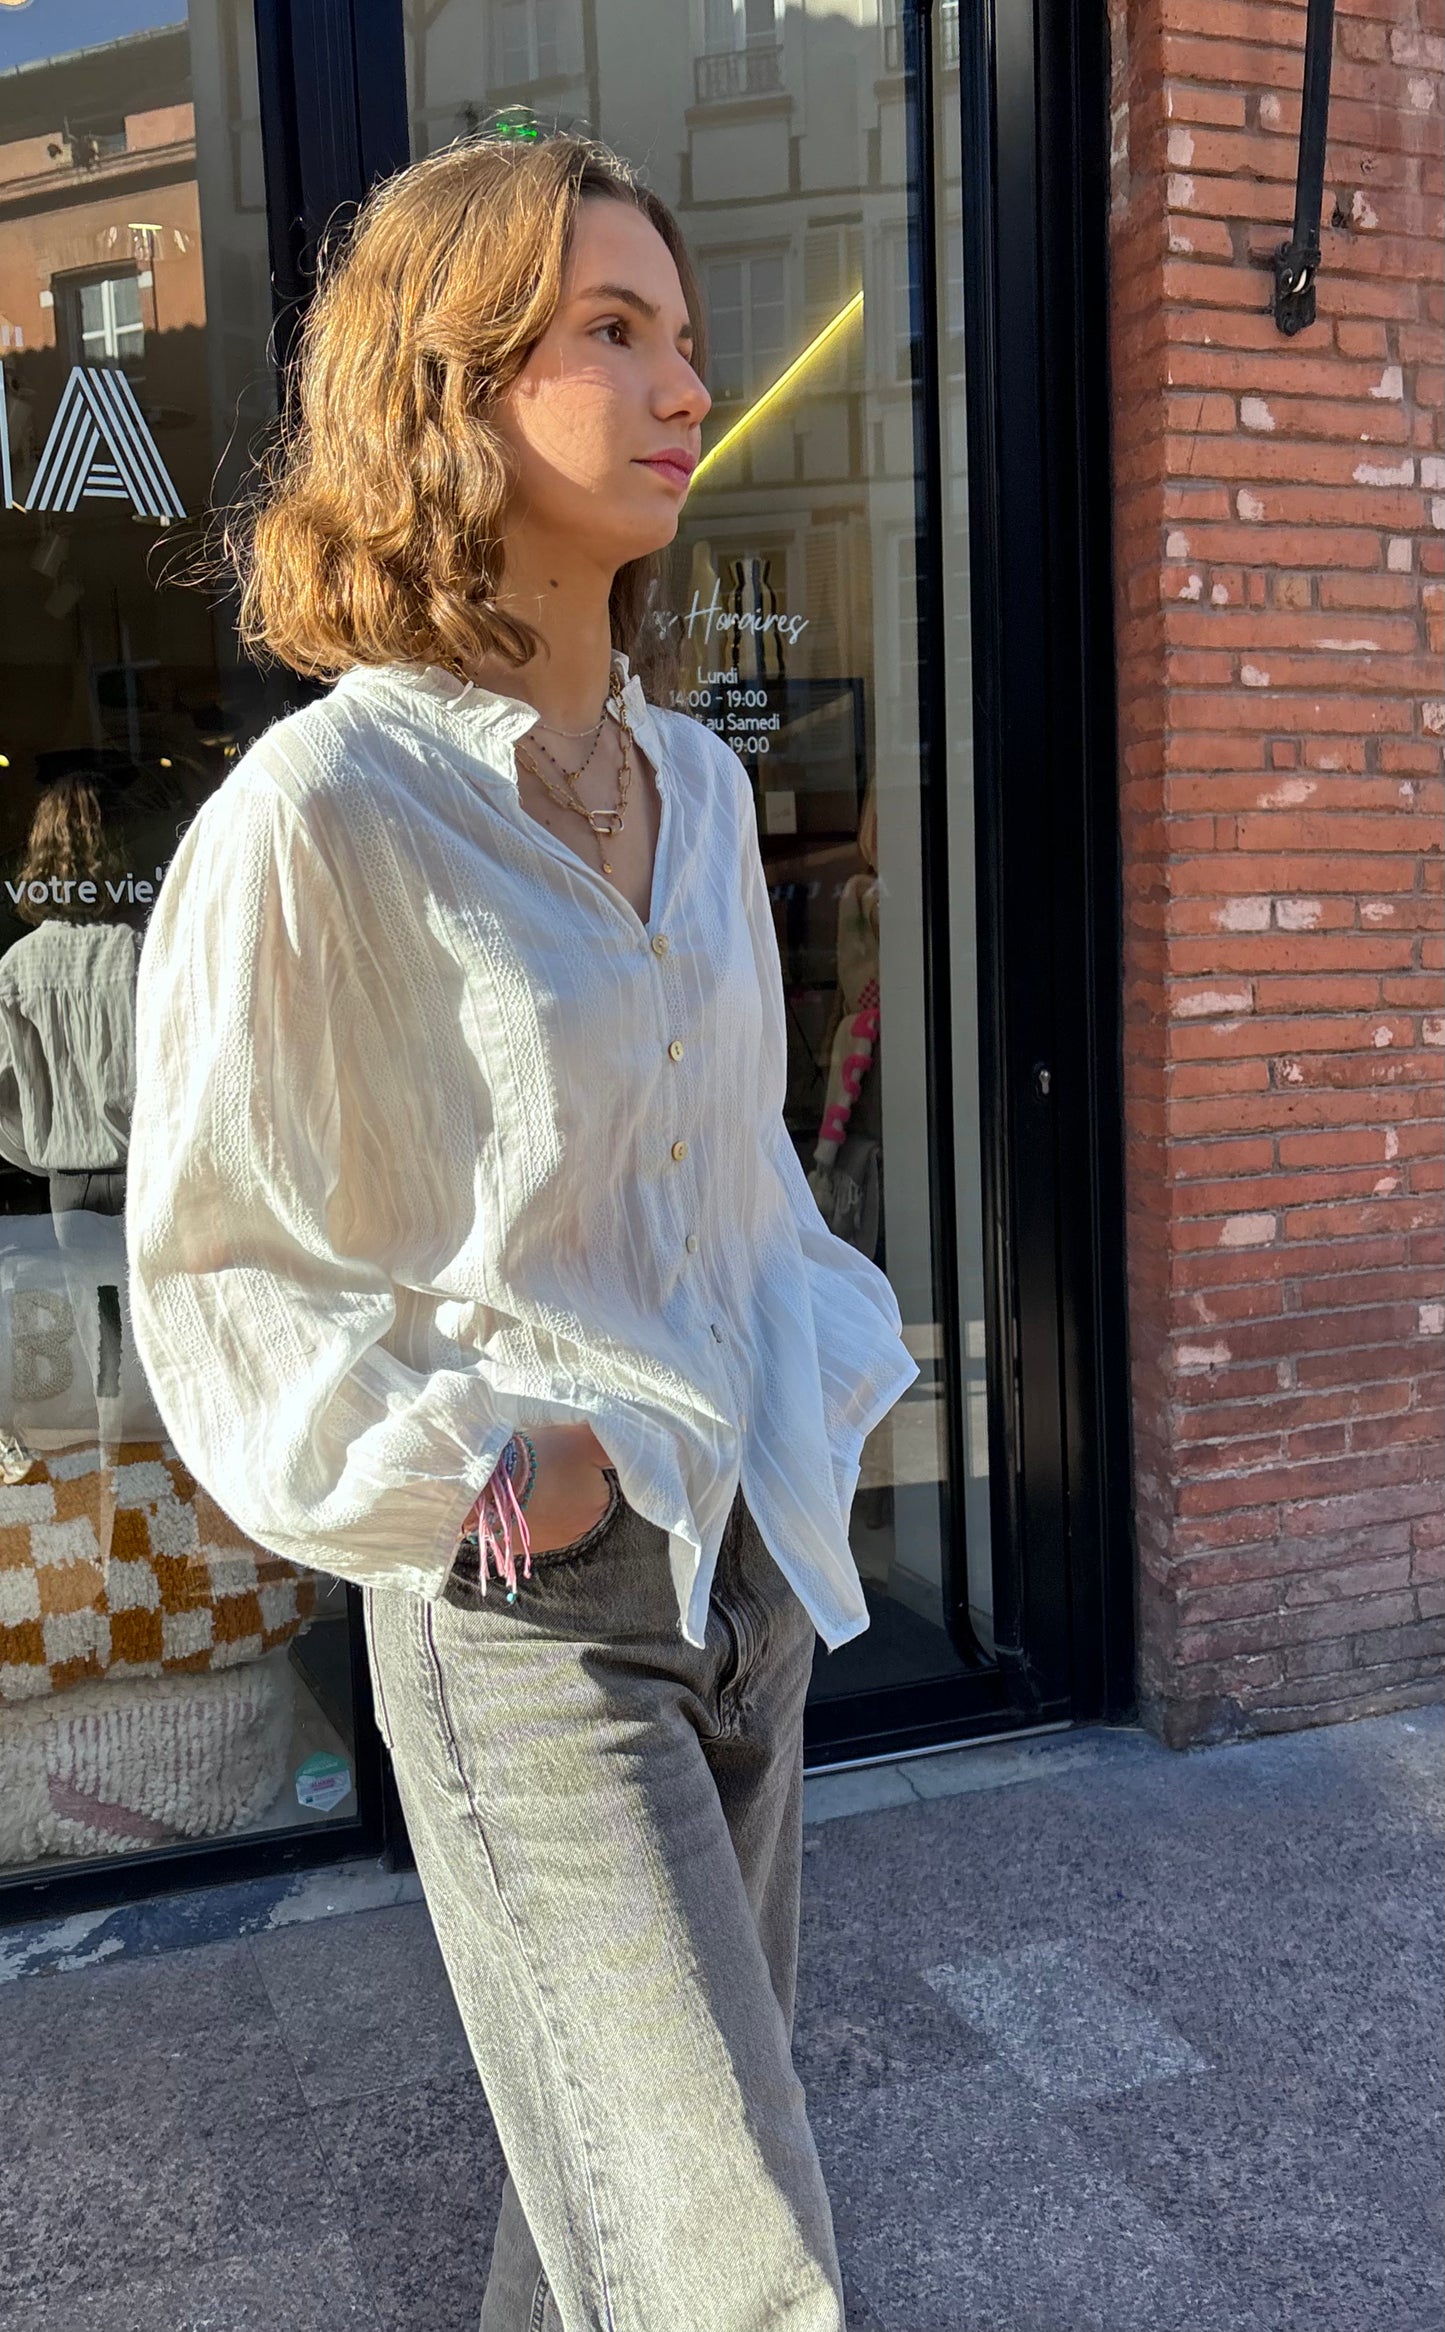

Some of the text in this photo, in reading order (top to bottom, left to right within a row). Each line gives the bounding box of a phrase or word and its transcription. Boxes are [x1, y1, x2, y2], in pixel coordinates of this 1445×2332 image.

[684, 577, 810, 645] Horaires
[697, 665, 739, 684] Lundi
[726, 689, 768, 708] 19:00
[726, 712, 780, 731] Samedi
[728, 736, 770, 754] 19:00
[4, 875, 97, 905] votre
